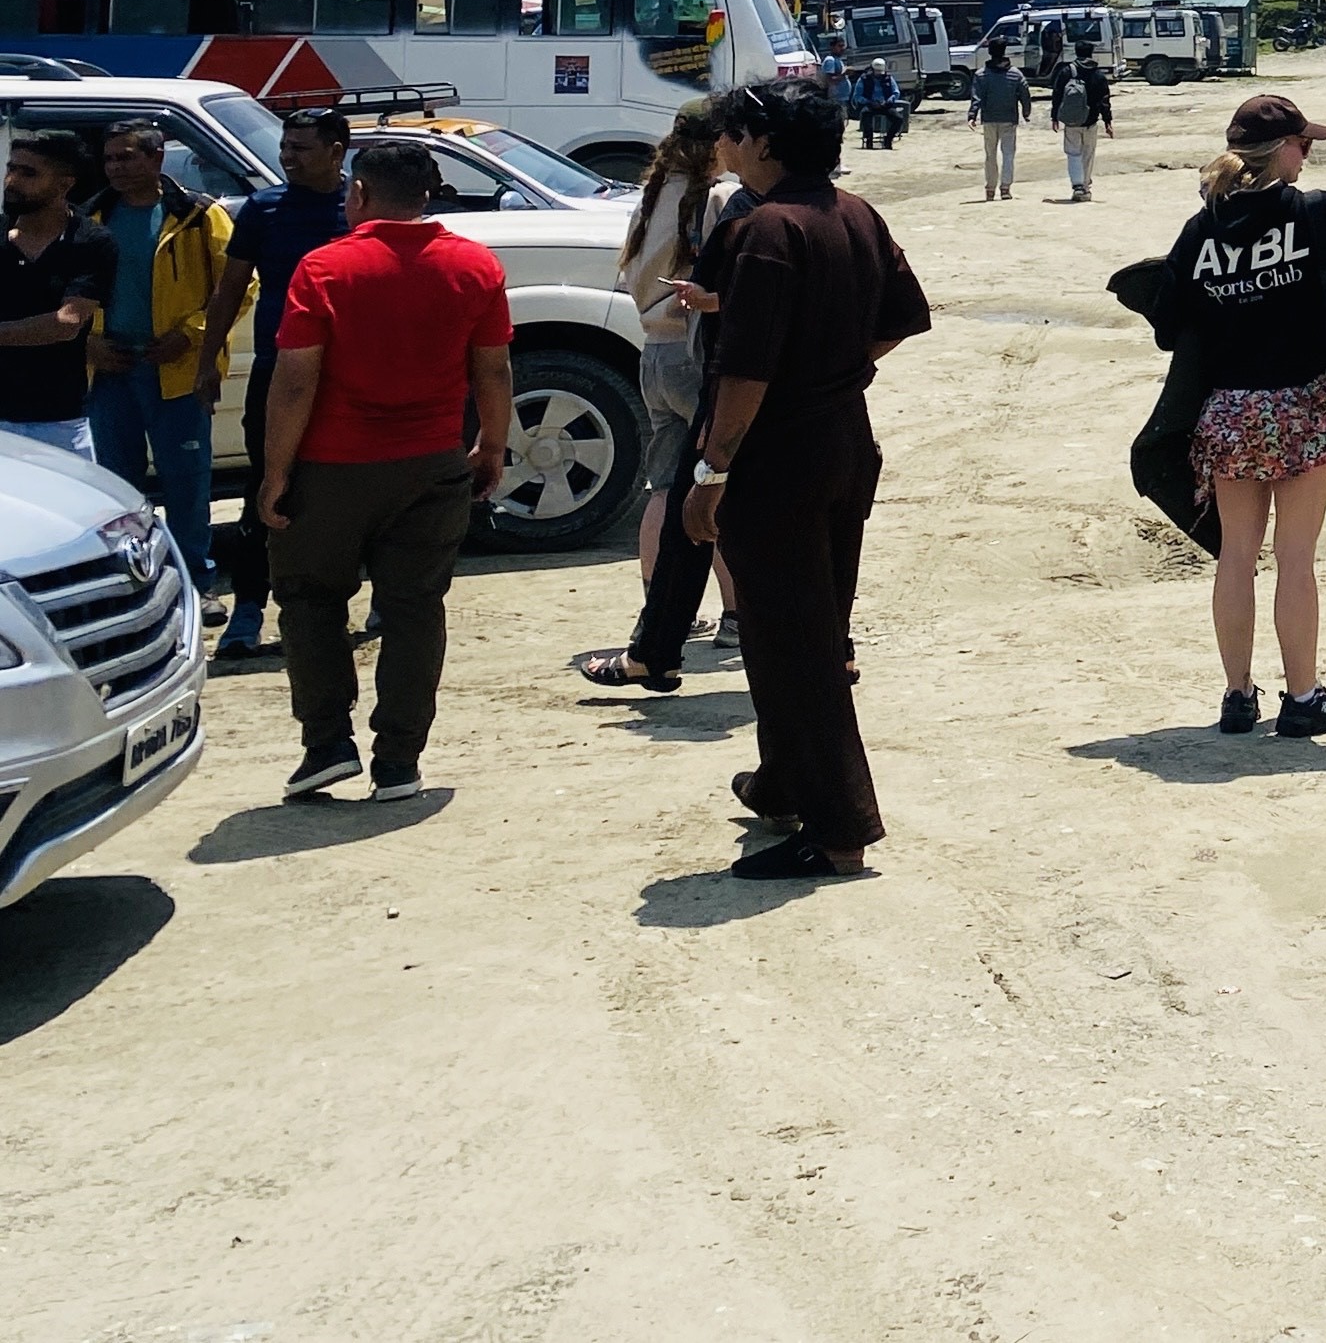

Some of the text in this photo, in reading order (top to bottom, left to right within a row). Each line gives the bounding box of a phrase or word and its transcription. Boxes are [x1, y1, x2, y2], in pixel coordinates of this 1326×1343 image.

[1192, 221, 1310, 280] AYBL
[1203, 264, 1303, 305] Sports Club
